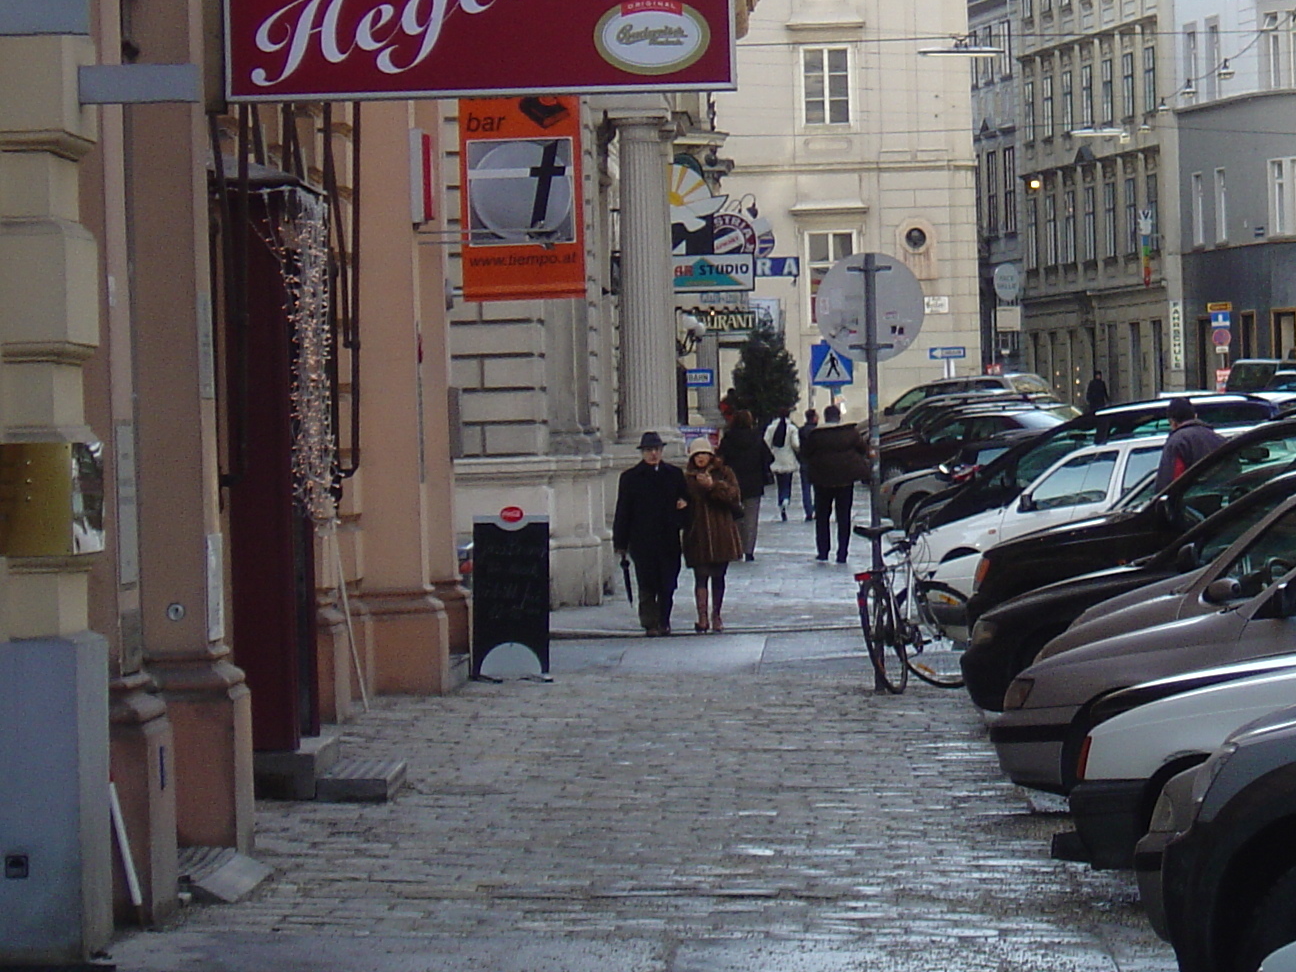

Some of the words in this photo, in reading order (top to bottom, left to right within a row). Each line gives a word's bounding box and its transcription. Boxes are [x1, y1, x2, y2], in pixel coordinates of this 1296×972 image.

[627, 0, 677, 10] ORIGINAL
[466, 113, 507, 133] bar
[699, 263, 749, 276] STUDIO
